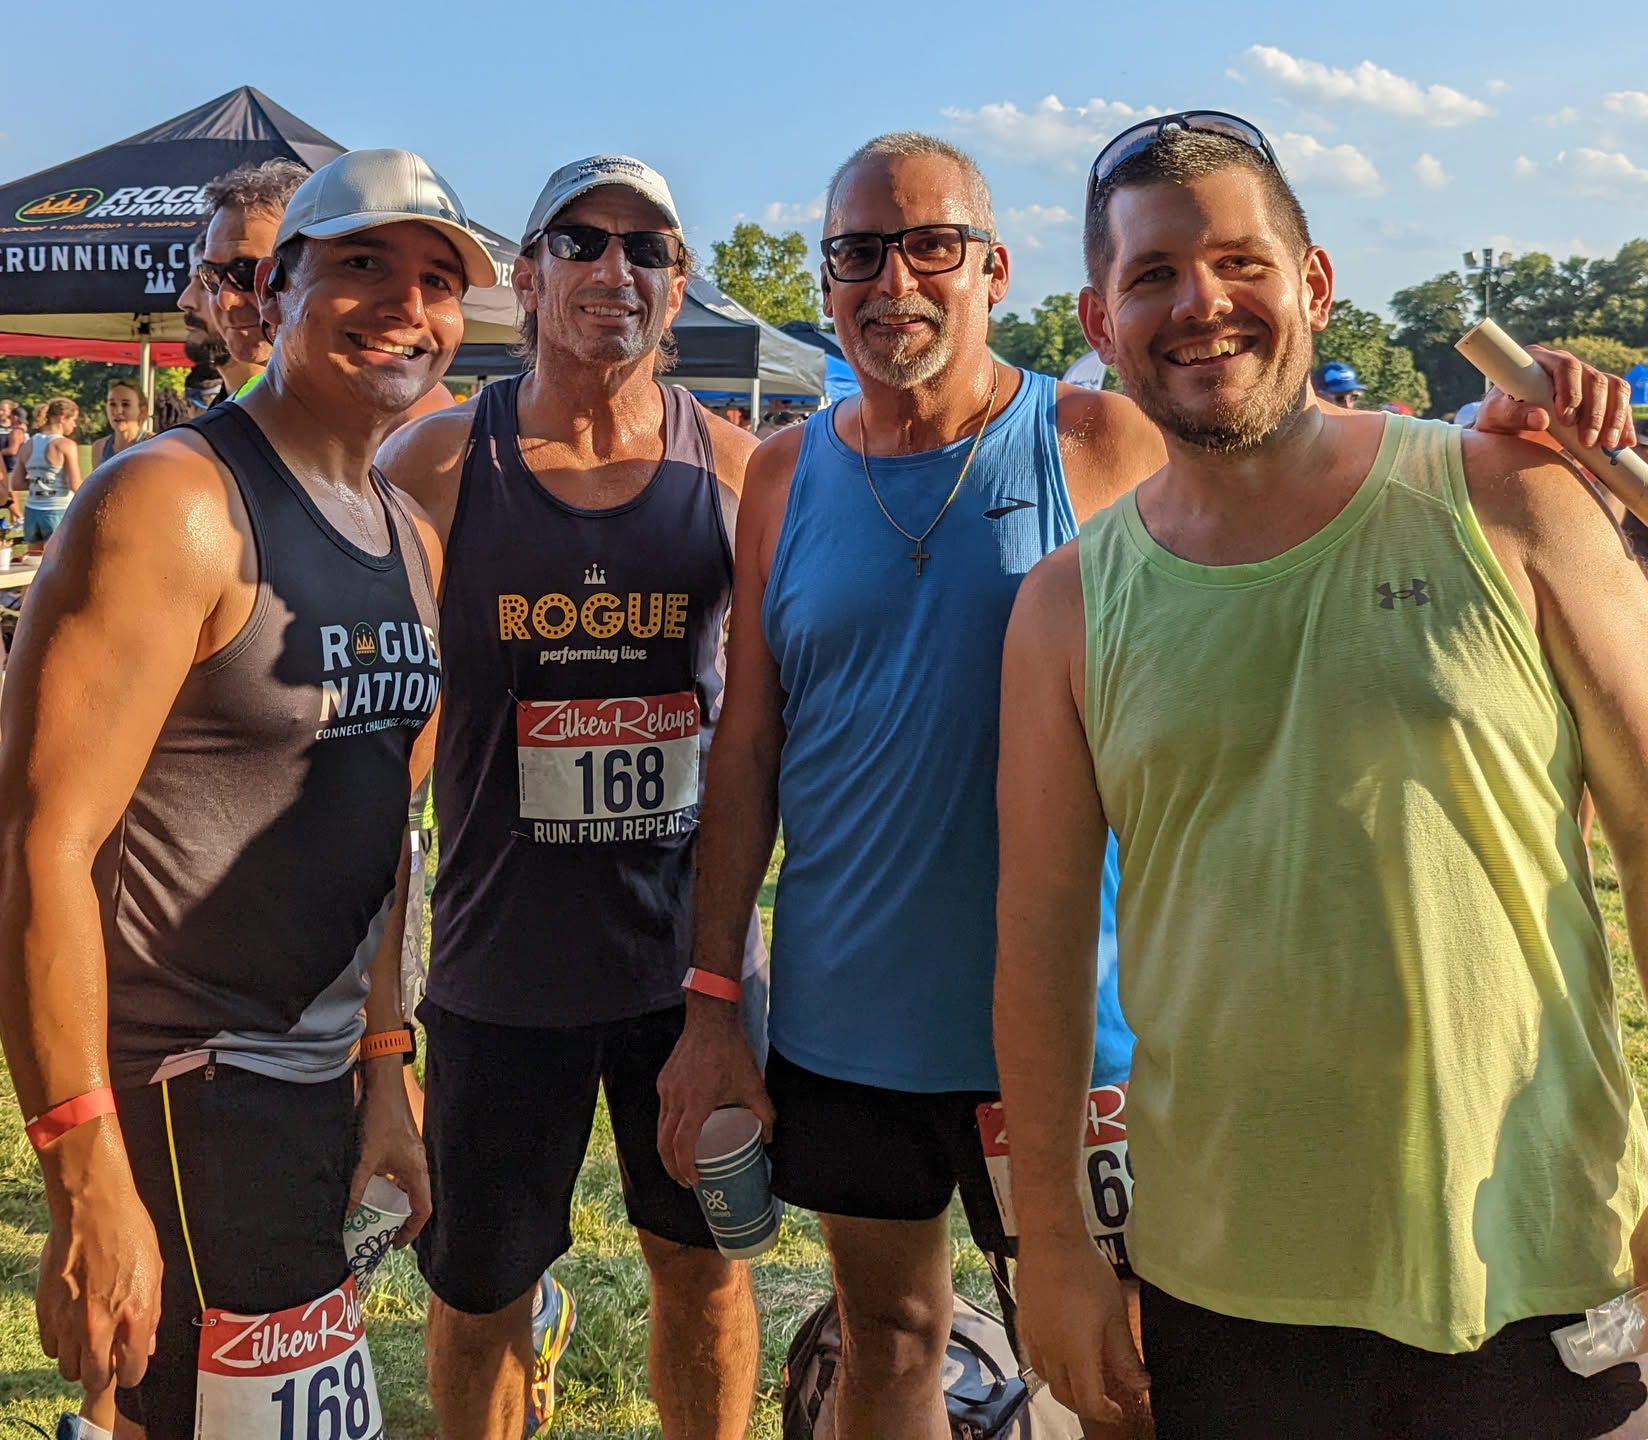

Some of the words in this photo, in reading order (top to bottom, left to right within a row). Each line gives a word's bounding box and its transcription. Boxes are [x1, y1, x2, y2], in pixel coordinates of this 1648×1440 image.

[85, 203, 204, 218] RUNNIN
[0, 243, 197, 273] RUNNING.C
[498, 592, 689, 641] ROGUE
[539, 646, 619, 665] performing
[620, 645, 648, 660] live
[319, 671, 440, 722] NATION
[528, 700, 611, 742] Zilker
[597, 696, 695, 740] Relays
[315, 723, 364, 740] CONNECT.
[574, 746, 665, 815] 168
[534, 821, 576, 845] RUN.
[578, 820, 620, 844] FUN.
[621, 811, 686, 841] REPEAT.
[211, 1312, 319, 1370] Zilker
[270, 1349, 371, 1440] 168
